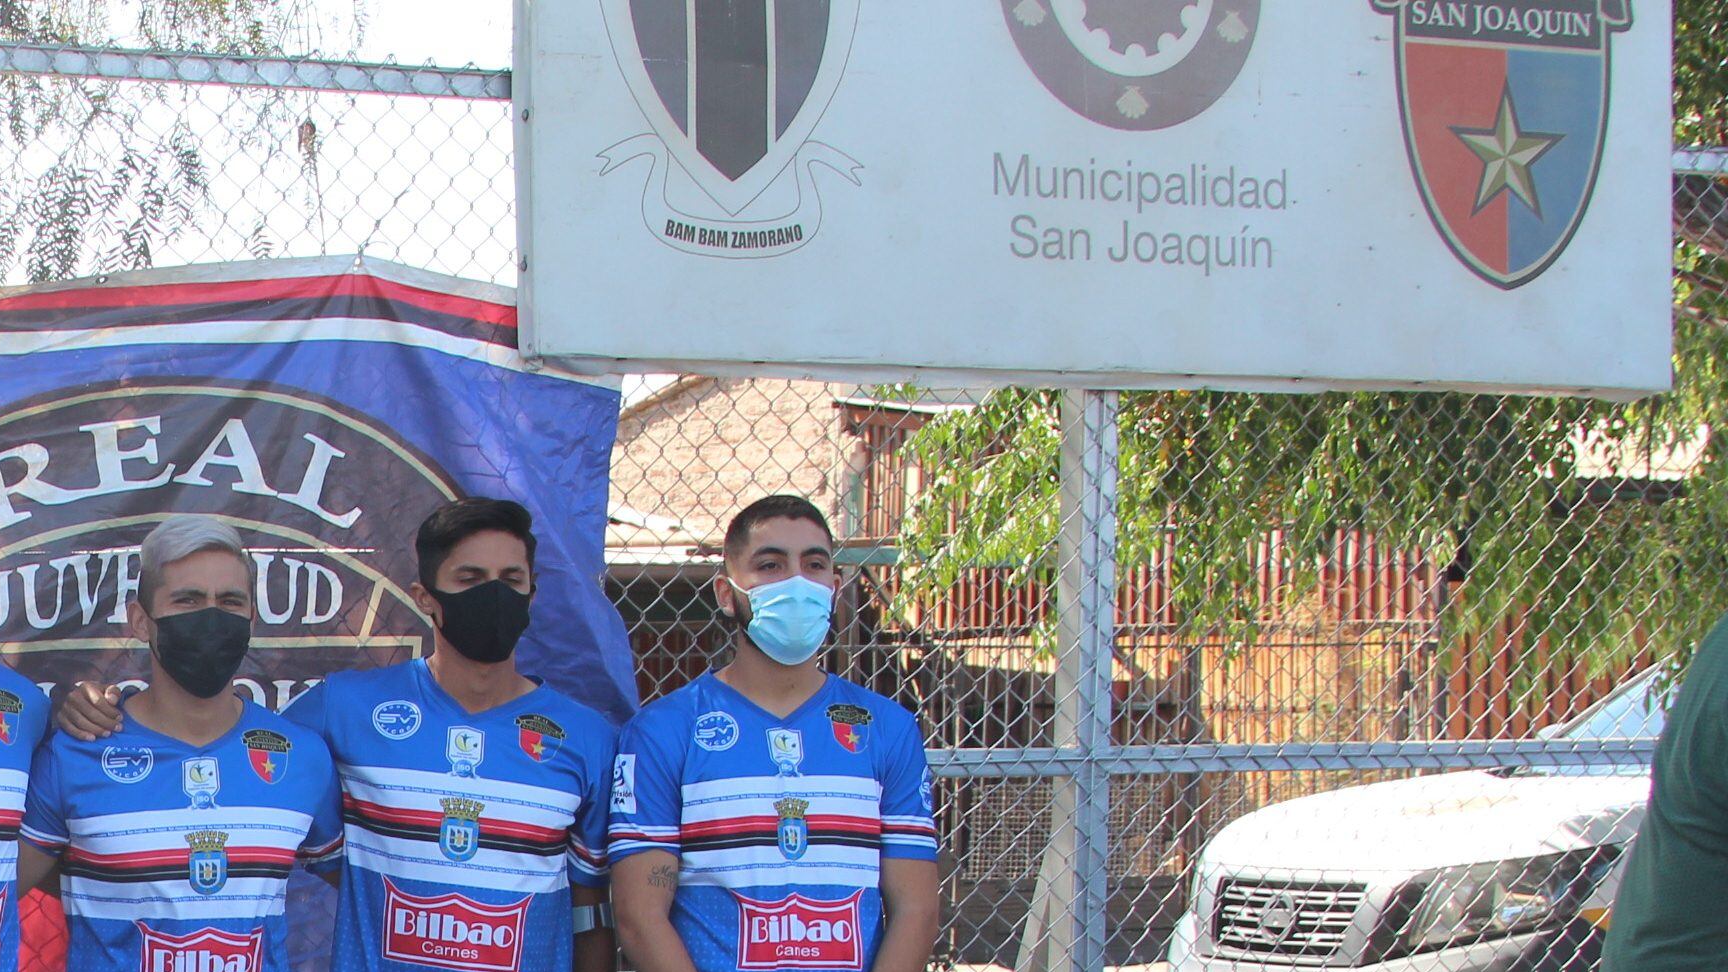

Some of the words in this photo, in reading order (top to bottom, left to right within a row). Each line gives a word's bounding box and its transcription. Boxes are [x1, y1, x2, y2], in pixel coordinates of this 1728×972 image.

[1412, 0, 1466, 28] SAN
[1472, 5, 1593, 38] JOAQUIN
[992, 151, 1288, 214] Municipalidad
[665, 218, 696, 243] BAM
[698, 227, 728, 249] BAM
[731, 223, 804, 249] ZAMORANO
[1010, 213, 1091, 261] San
[1108, 219, 1273, 277] Joaquín
[394, 907, 515, 948] Bilbao
[750, 914, 852, 944] Bilbao
[421, 941, 479, 961] Carnes
